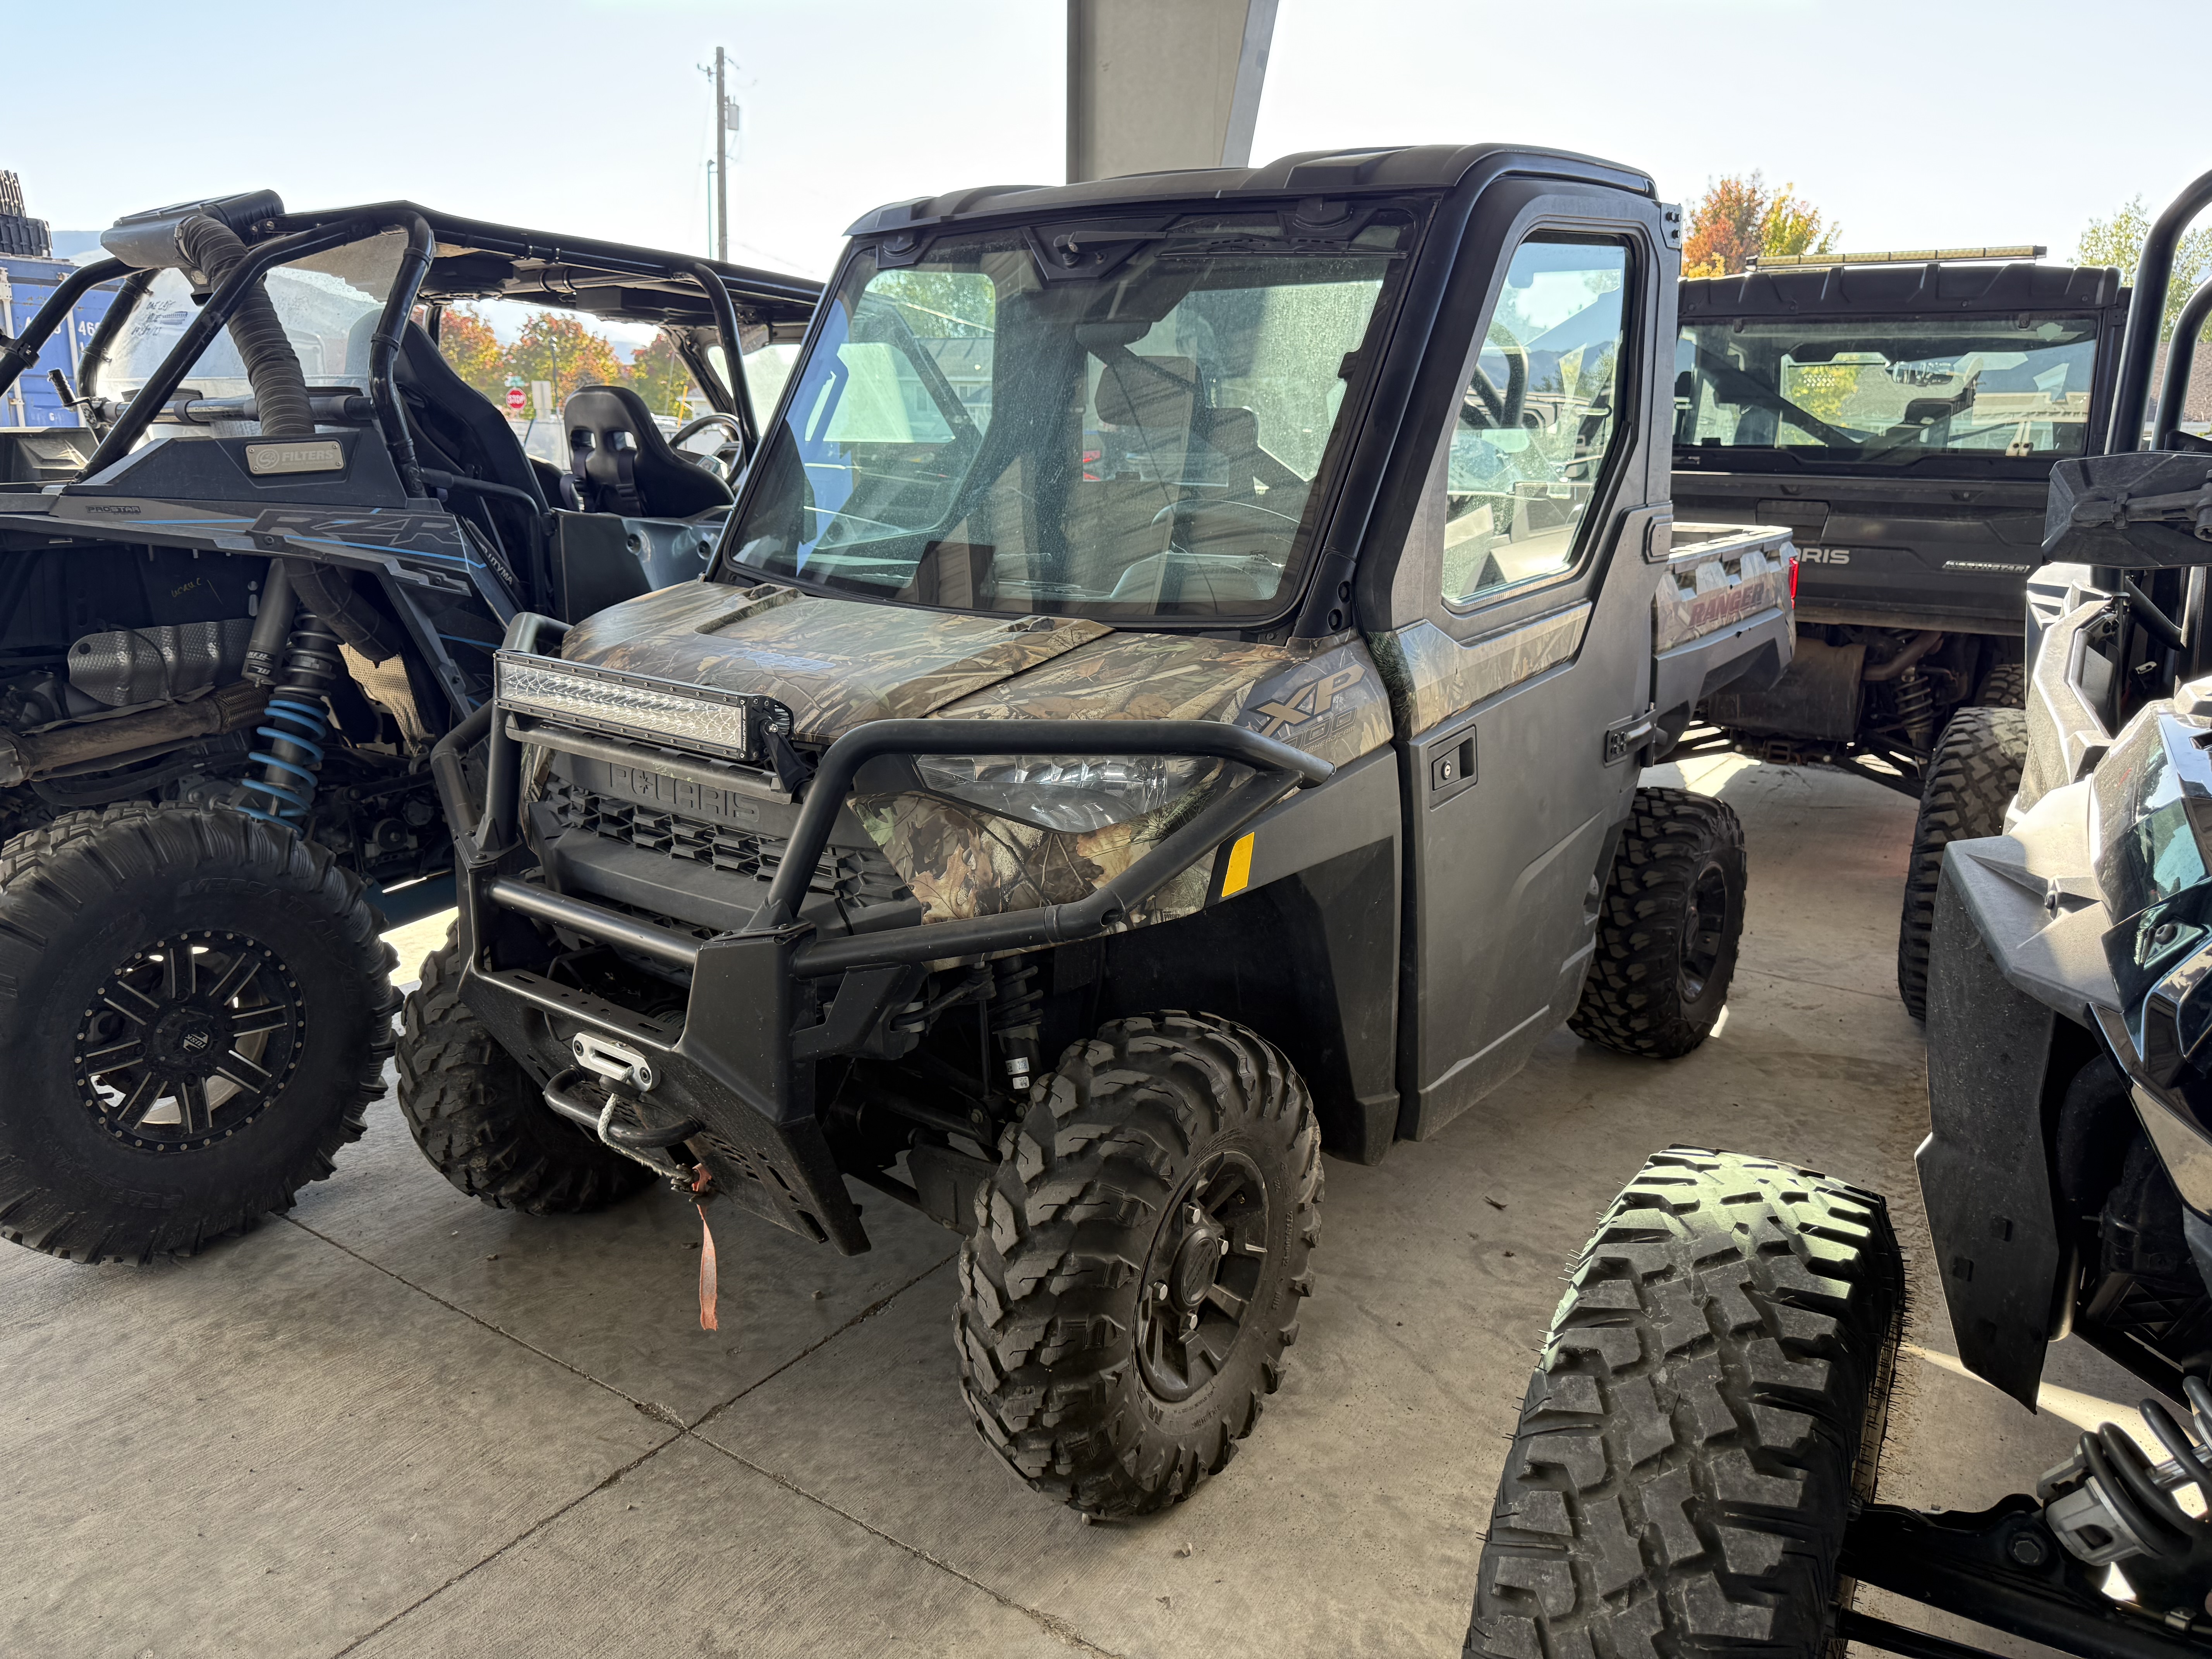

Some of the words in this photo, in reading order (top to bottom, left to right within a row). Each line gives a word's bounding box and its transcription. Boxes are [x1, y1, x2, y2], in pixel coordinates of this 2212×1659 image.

[507, 395, 525, 404] STOP
[282, 450, 333, 462] FILTERS
[252, 509, 467, 546] RZR
[1689, 582, 1766, 629] RANGER
[1250, 661, 1368, 738] XP
[1304, 735, 1336, 753] ERHEAD
[1338, 726, 1355, 738] CAM
[610, 762, 760, 823] POLARIS
[185, 1034, 206, 1049] TUSK
